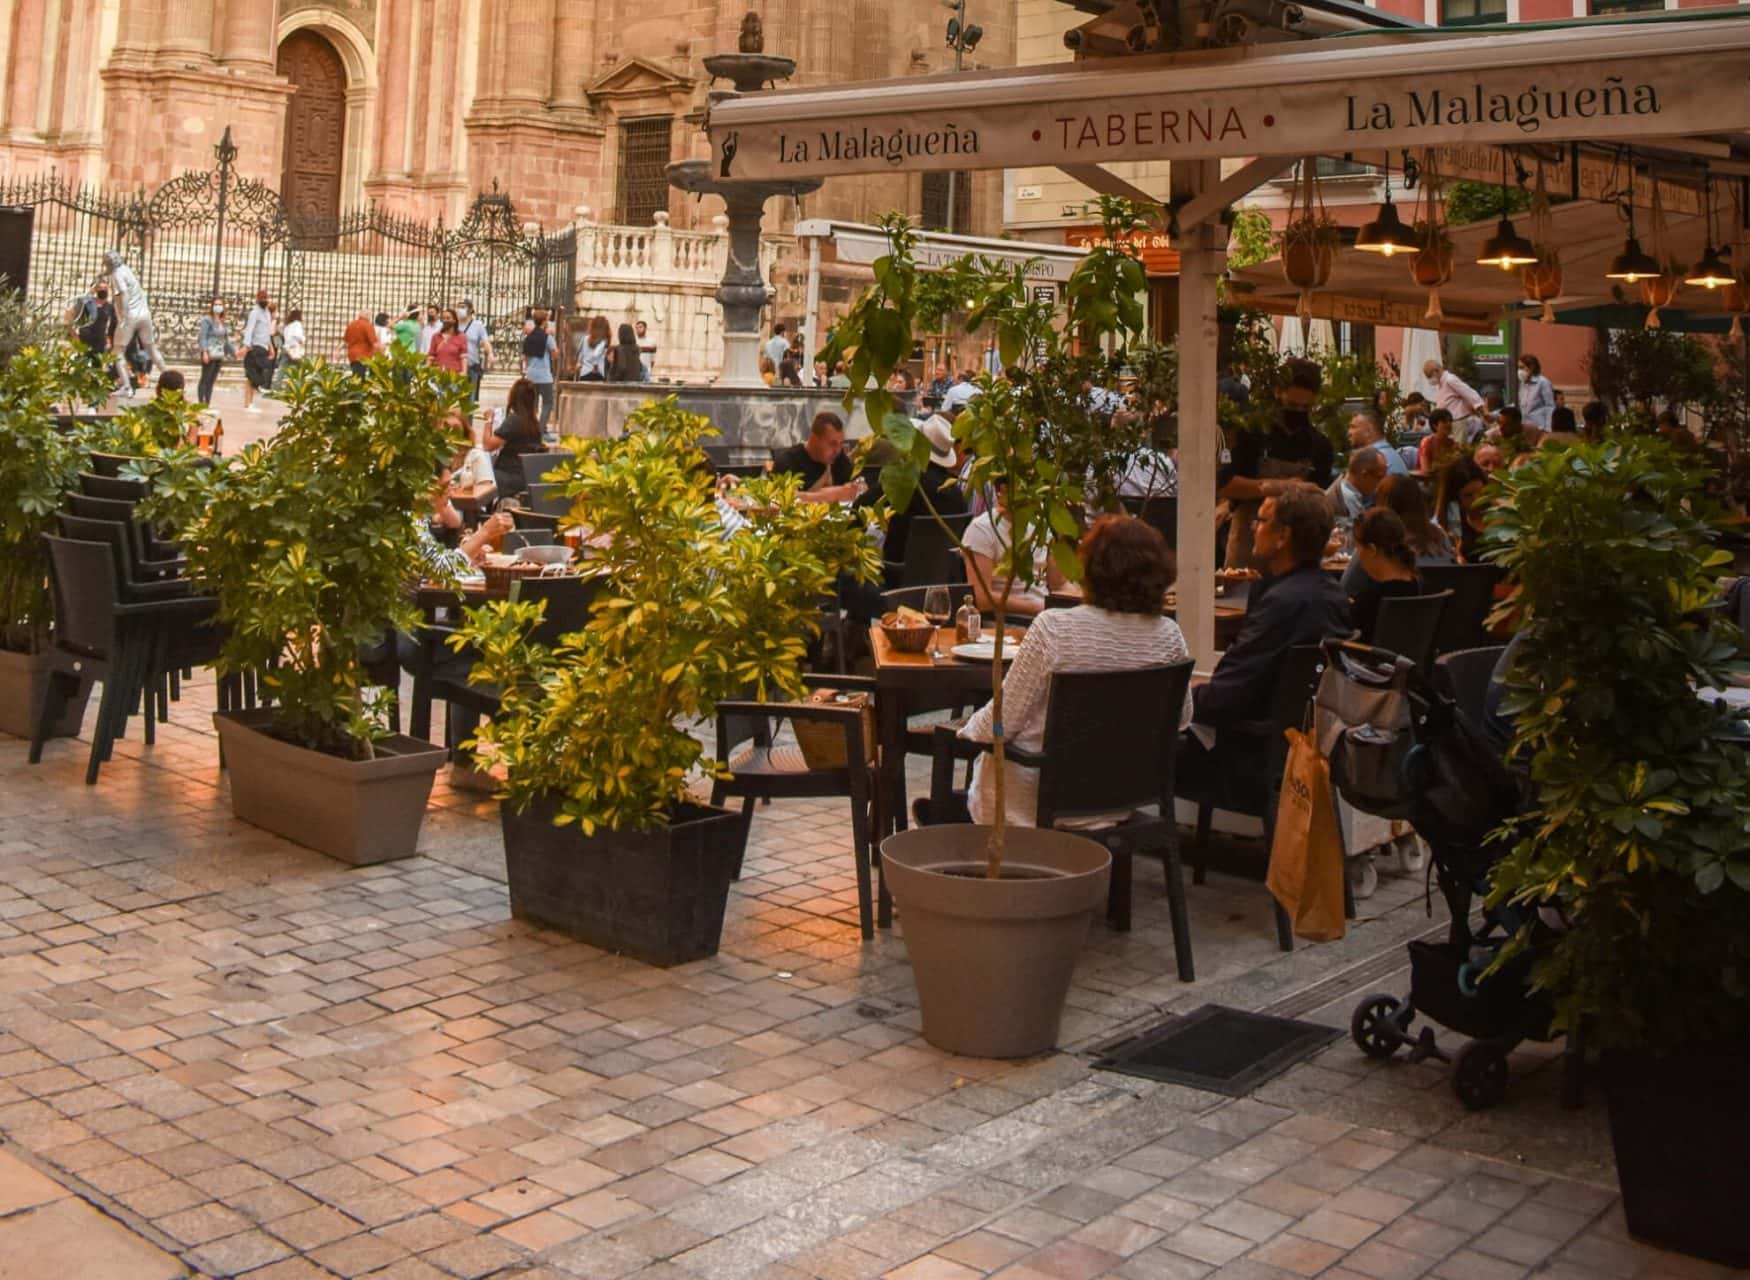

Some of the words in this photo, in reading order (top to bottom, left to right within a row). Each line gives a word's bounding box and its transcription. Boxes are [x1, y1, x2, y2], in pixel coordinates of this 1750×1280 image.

[778, 134, 809, 163] La
[817, 123, 980, 166] Malagueña
[1055, 106, 1248, 150] TABERNA
[1343, 95, 1395, 131] La
[1403, 76, 1662, 133] Malagueña
[927, 252, 942, 267] LA
